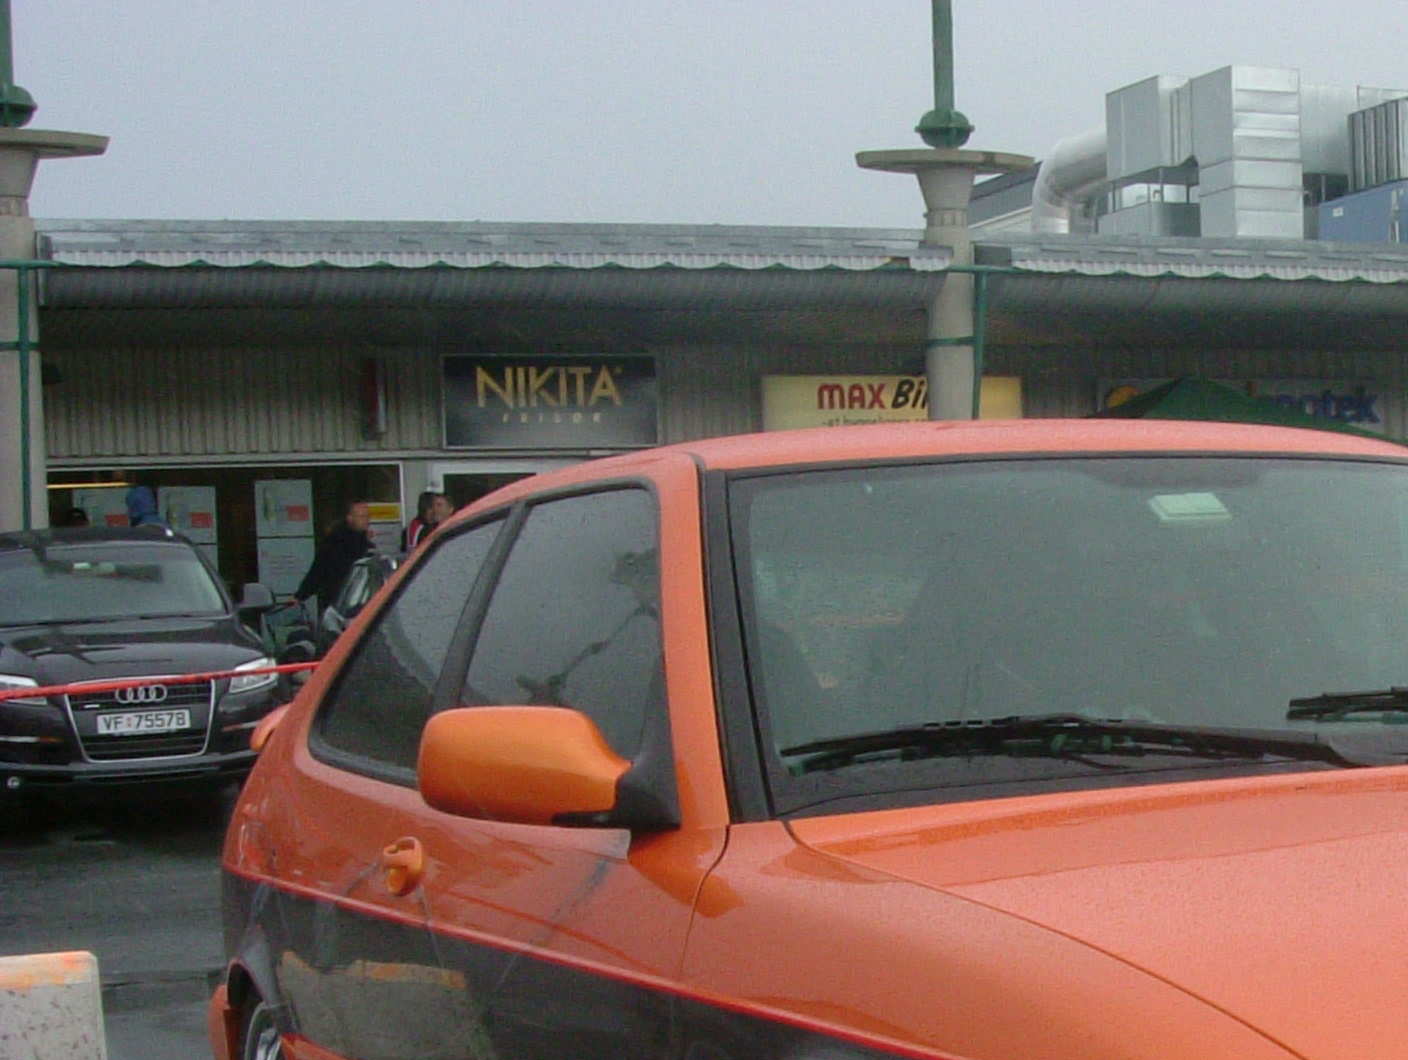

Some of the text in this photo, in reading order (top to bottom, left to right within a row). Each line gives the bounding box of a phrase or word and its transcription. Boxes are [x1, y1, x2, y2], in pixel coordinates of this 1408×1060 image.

[475, 365, 622, 408] NIKITA
[890, 377, 929, 410] Bi
[102, 715, 124, 731] VF
